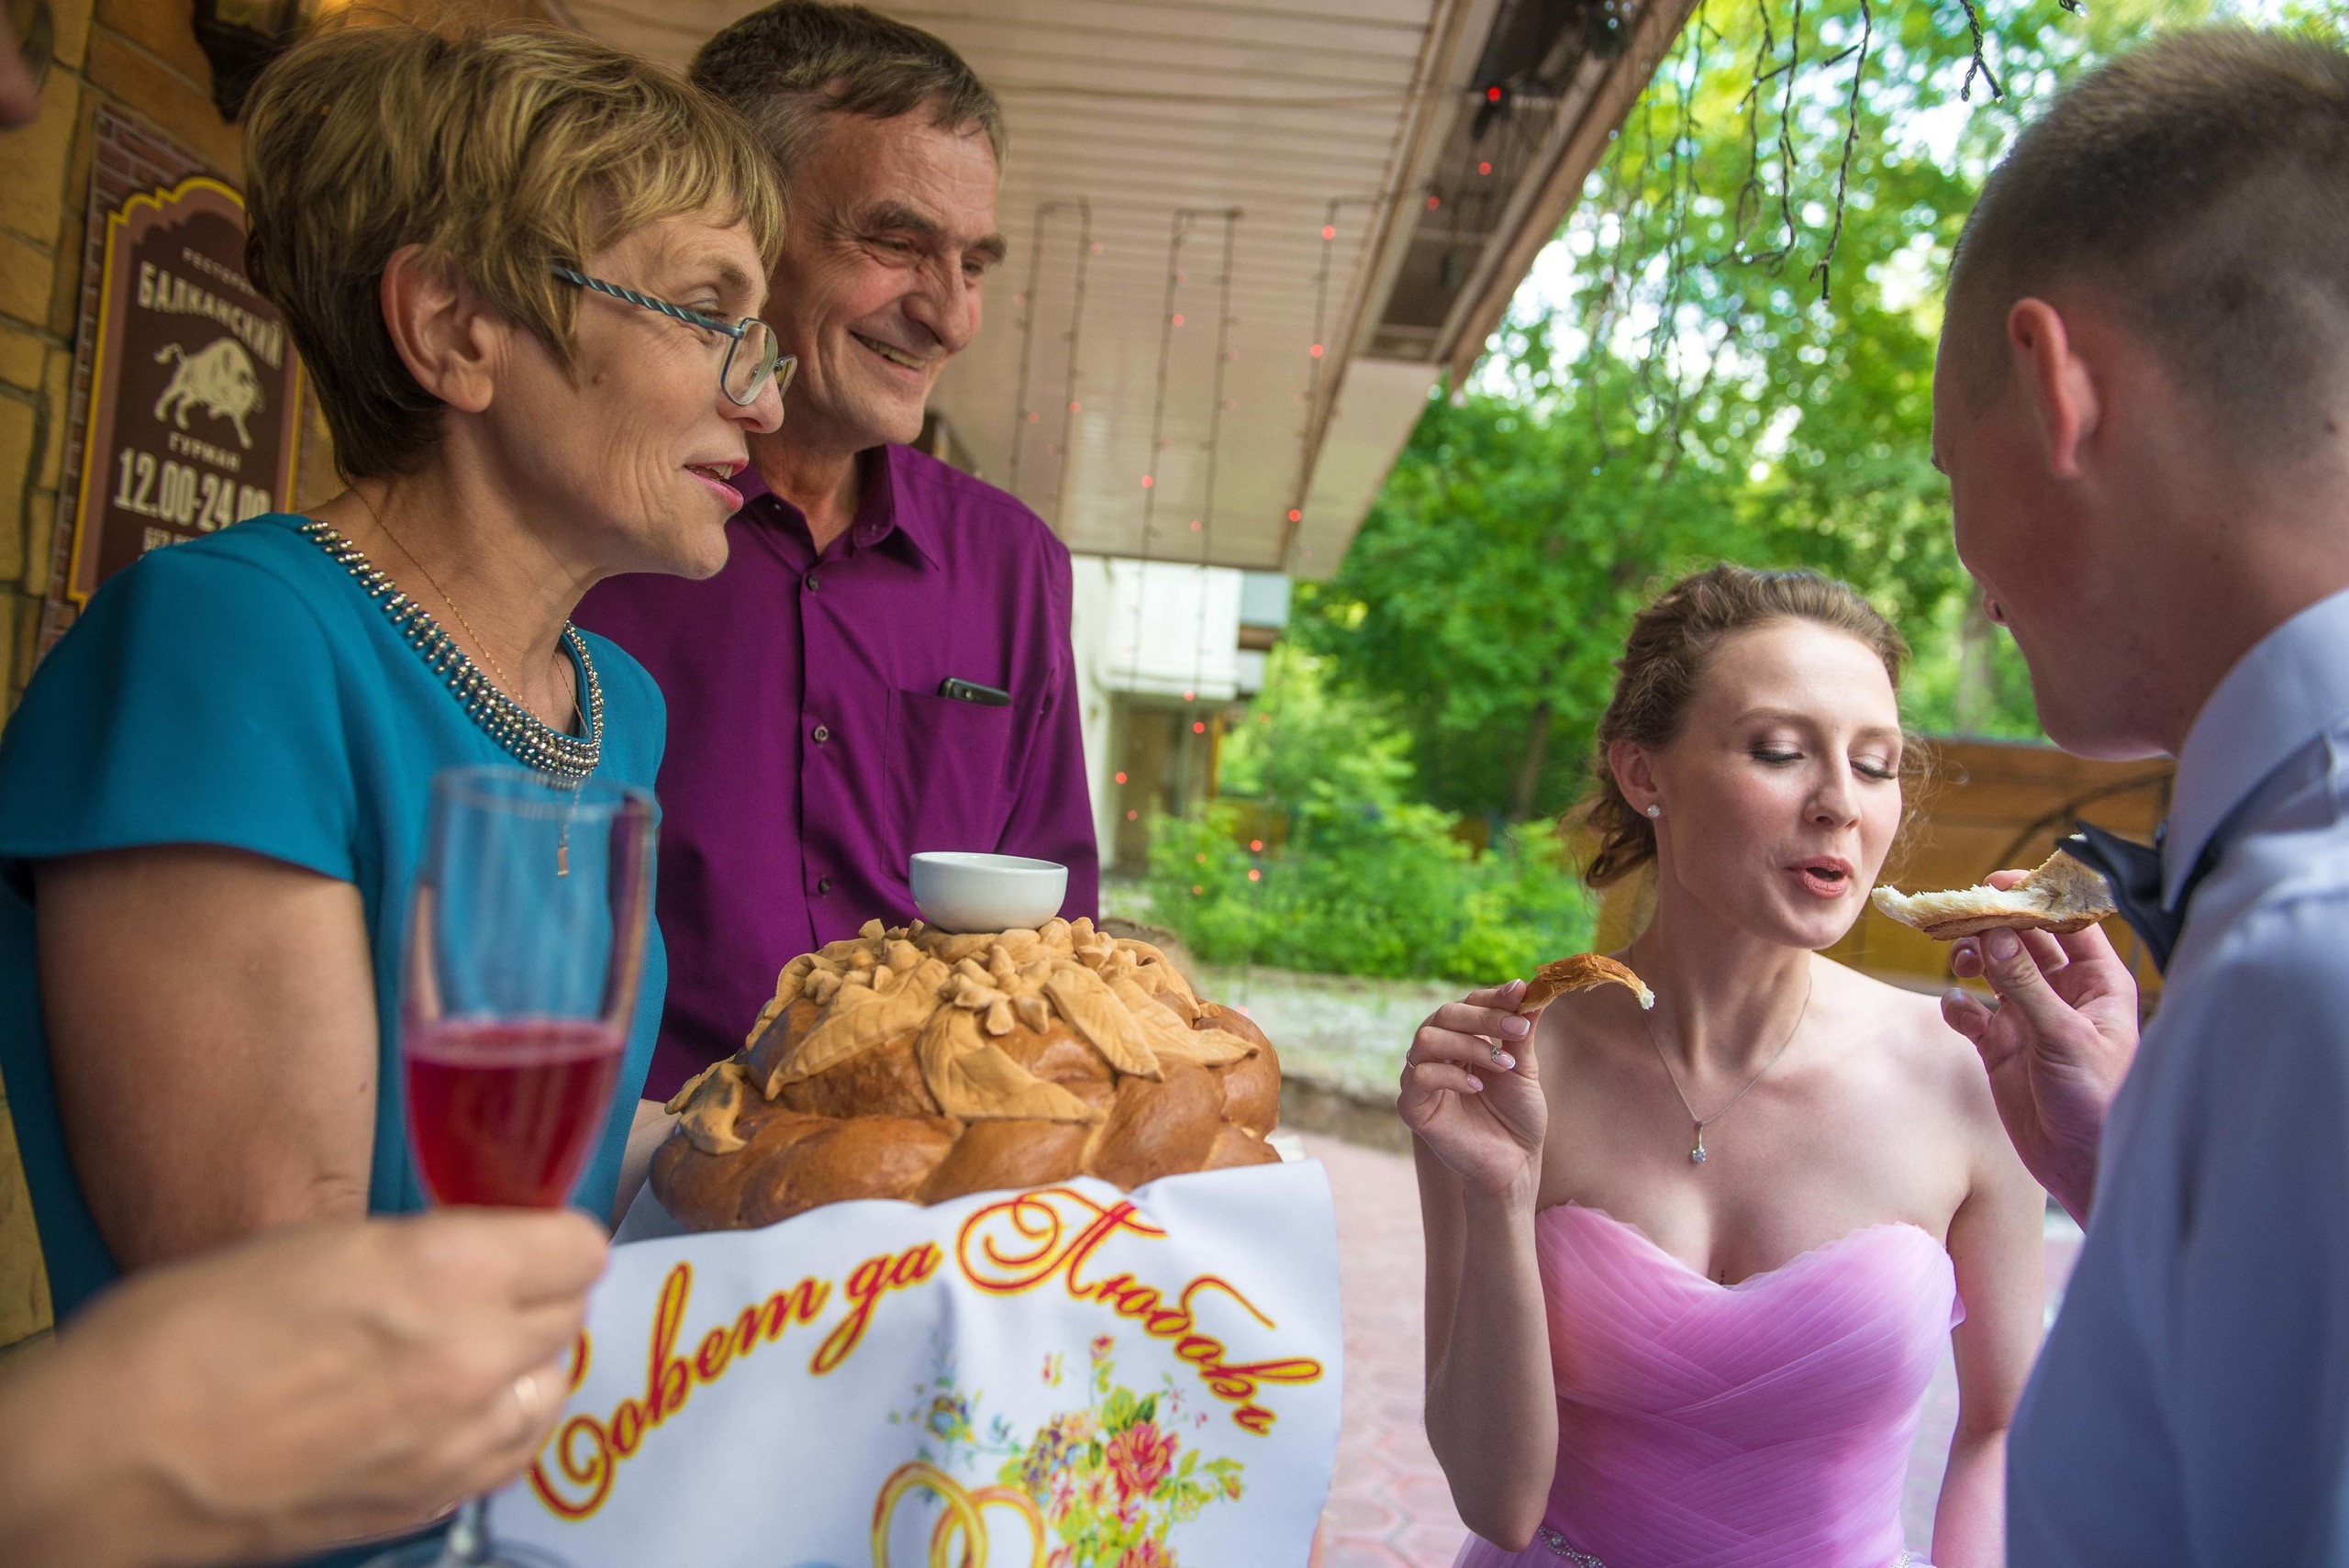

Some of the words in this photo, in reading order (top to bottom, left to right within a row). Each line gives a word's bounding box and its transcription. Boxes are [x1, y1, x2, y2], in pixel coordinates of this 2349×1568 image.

[139, 260, 284, 370] БАЛКАНСКИЙ
[114, 447, 273, 532] 12.00-240
[168, 430, 241, 473] ГУРМАН
[808, 1241, 944, 1376] да
[955, 1186, 1322, 1437] Любовь
